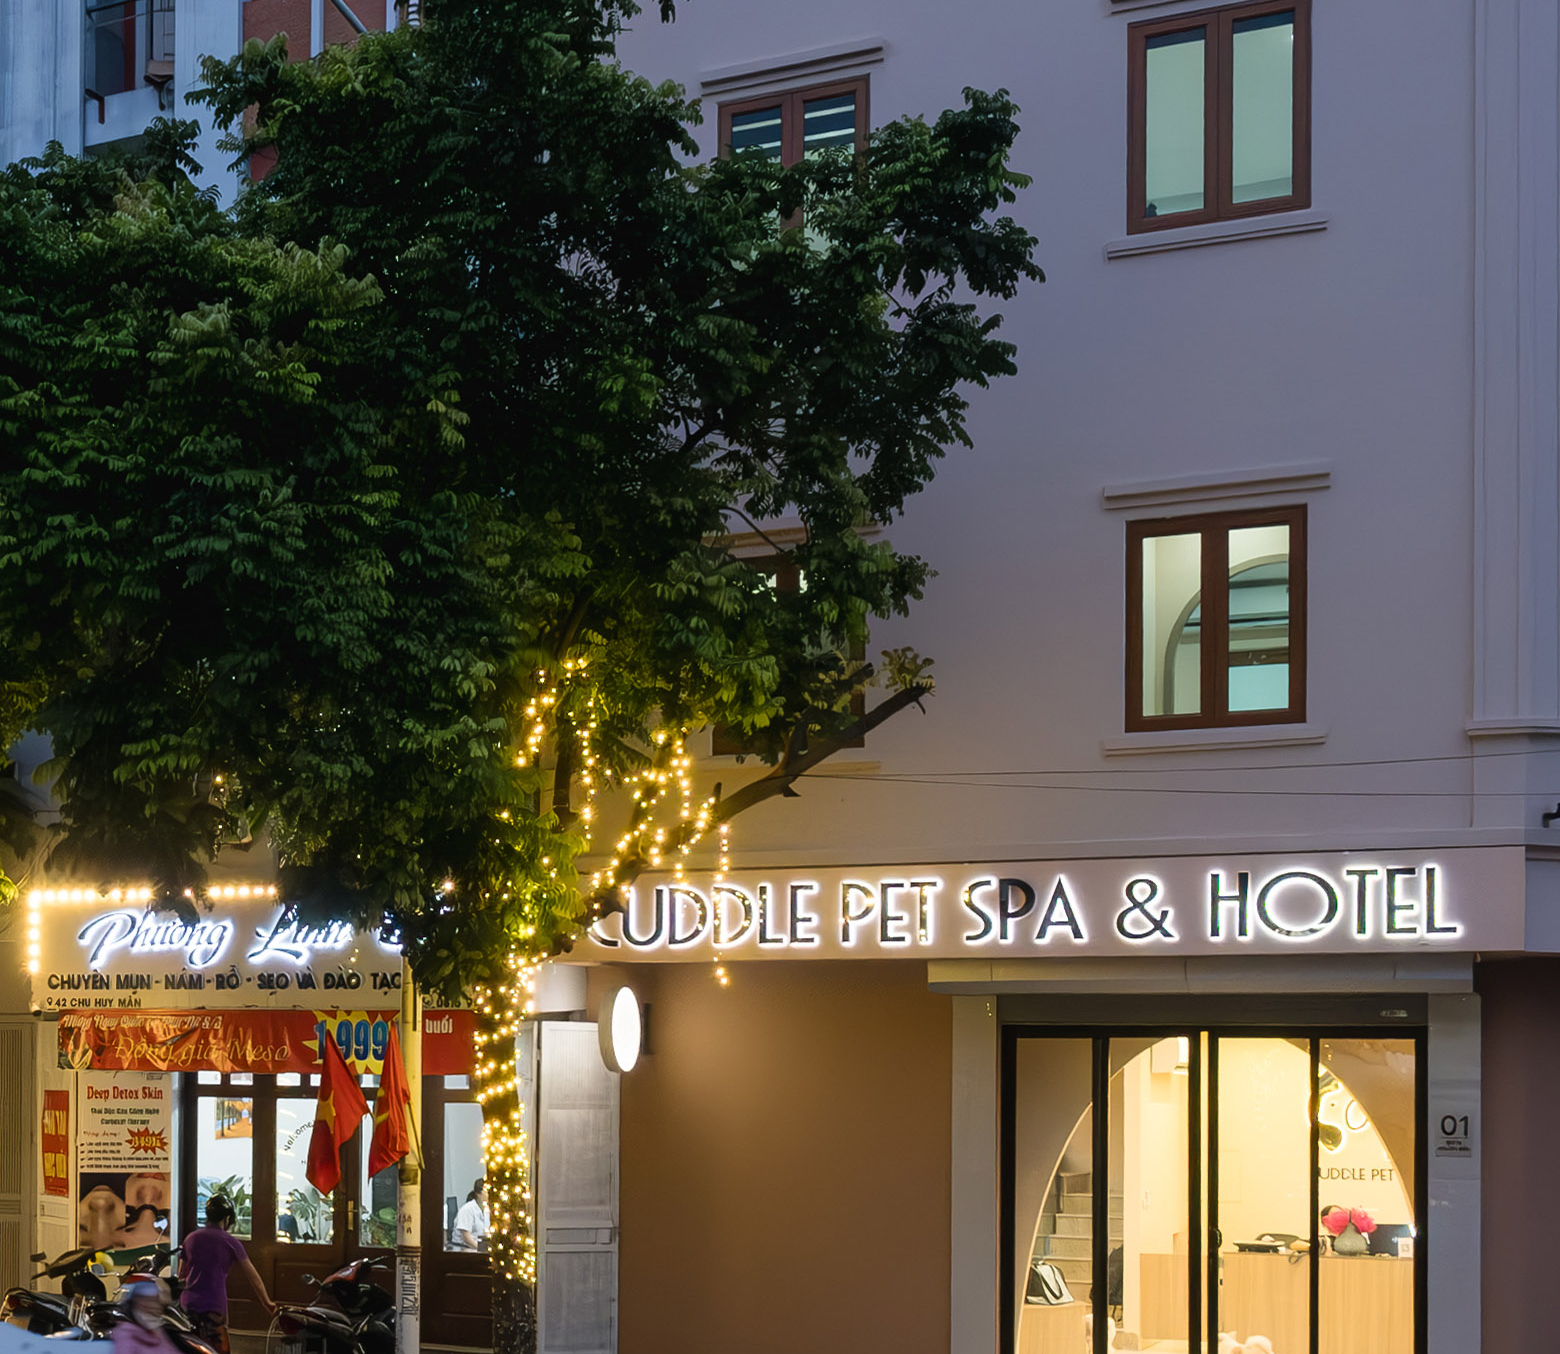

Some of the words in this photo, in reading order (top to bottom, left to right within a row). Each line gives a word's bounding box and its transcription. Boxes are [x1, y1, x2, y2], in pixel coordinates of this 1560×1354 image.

[841, 880, 939, 943] PET
[964, 876, 1084, 942] SPA
[1116, 878, 1177, 940] &
[1210, 867, 1458, 938] HOTEL
[48, 969, 110, 990] CHUYÊN
[116, 974, 151, 995] MỤN
[55, 997, 67, 1007] 42
[70, 997, 91, 1007] CHU
[94, 997, 114, 1007] HUY
[142, 1086, 164, 1100] Skin
[1440, 1115, 1469, 1137] 01
[1318, 1167, 1366, 1180] UDDLE
[1371, 1168, 1394, 1182] PET
